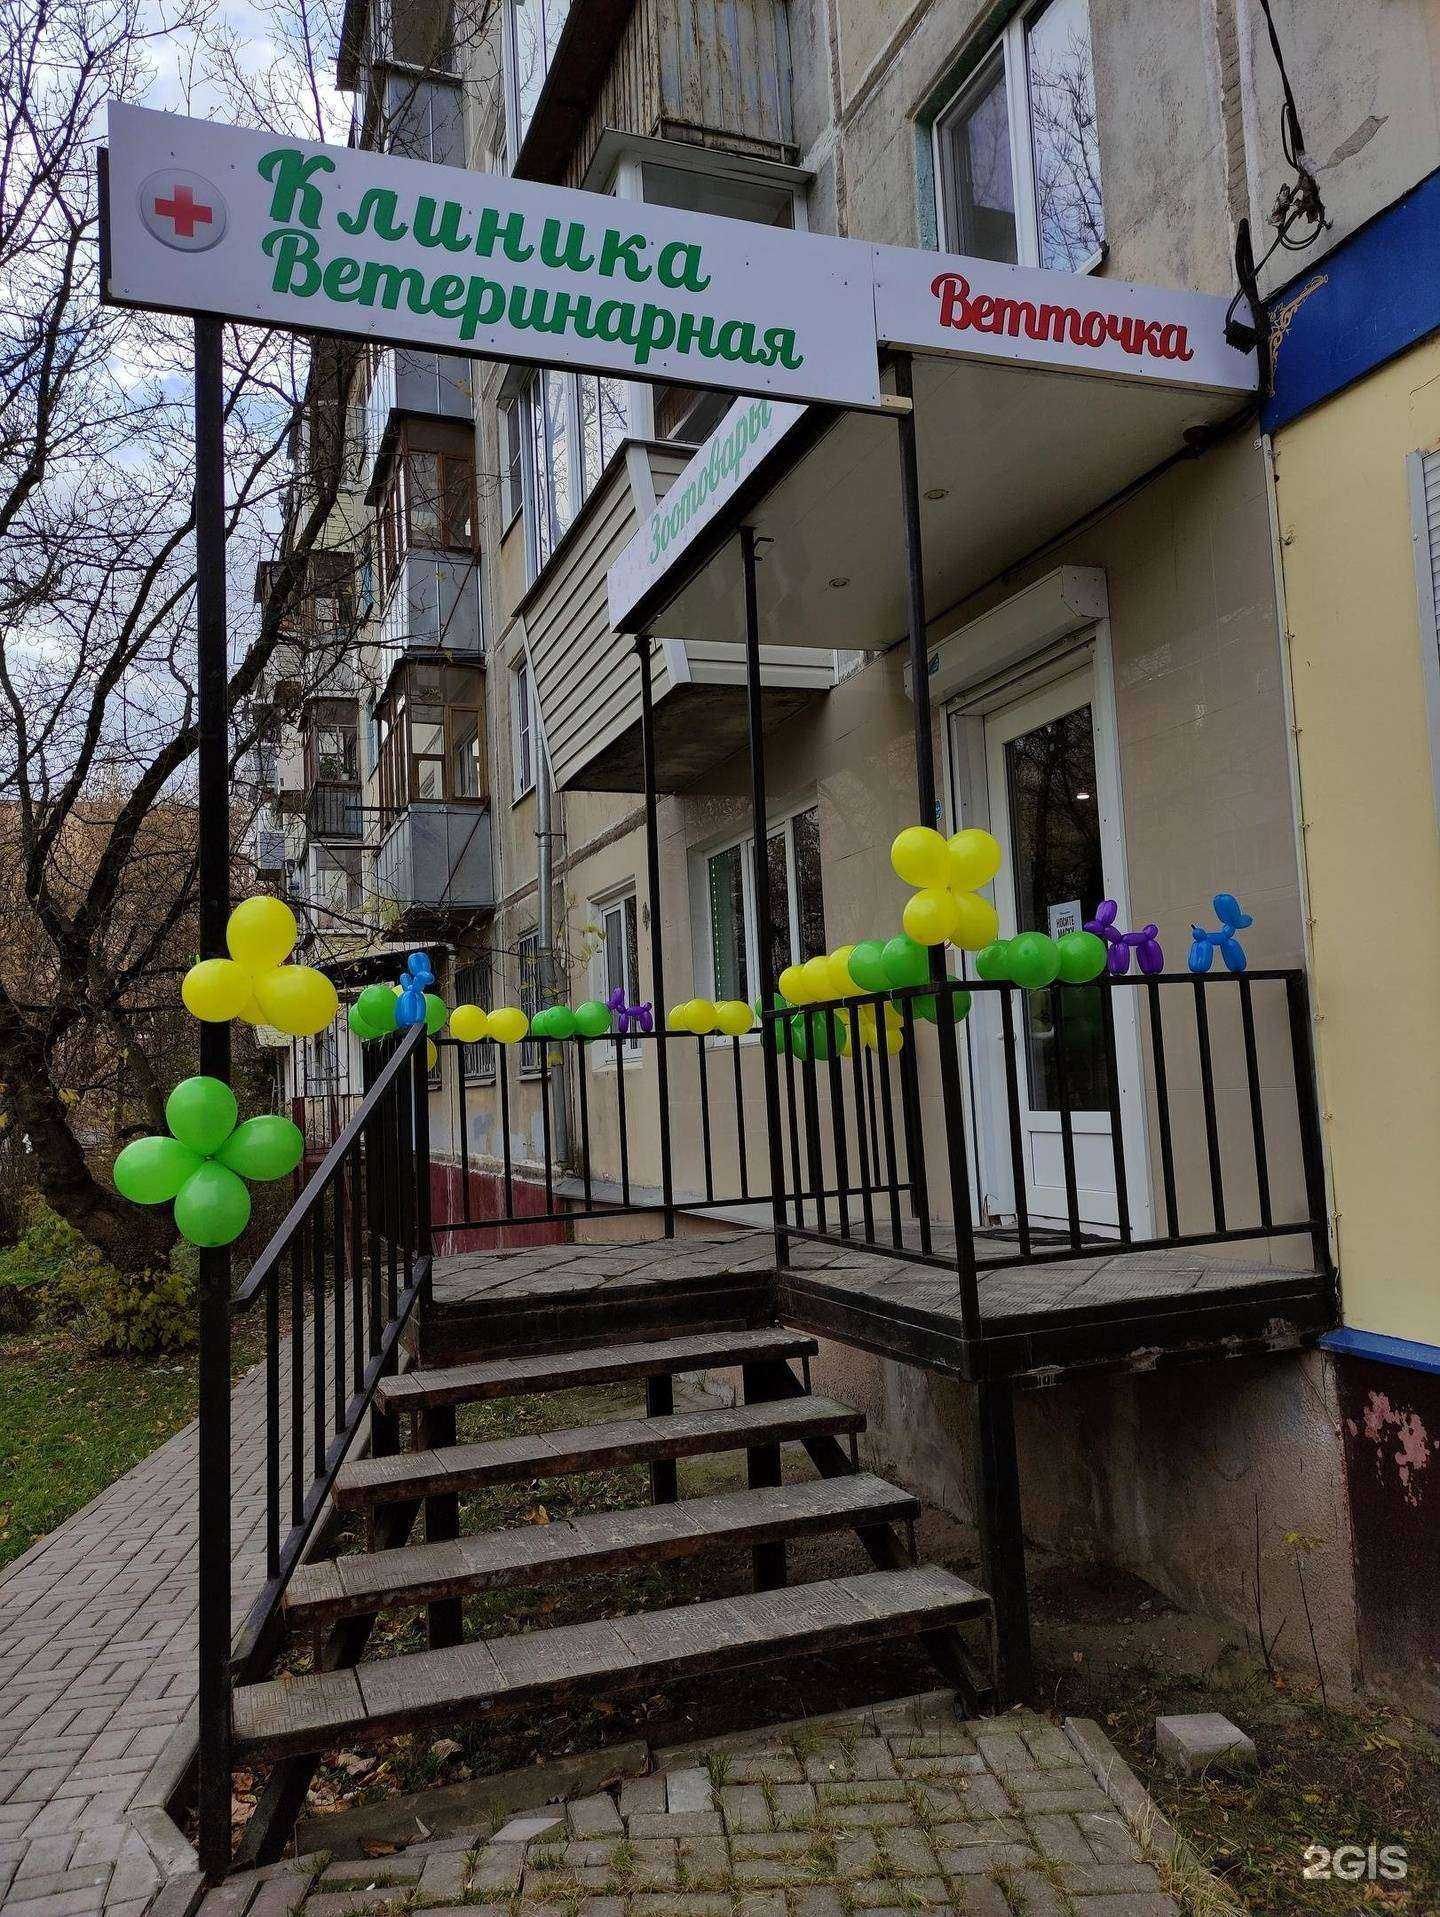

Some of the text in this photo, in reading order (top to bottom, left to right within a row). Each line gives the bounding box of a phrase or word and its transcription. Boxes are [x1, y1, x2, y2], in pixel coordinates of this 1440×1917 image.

[257, 149, 711, 293] Клиника
[261, 228, 804, 370] Ветеринарная
[930, 272, 1194, 361] Ветточка
